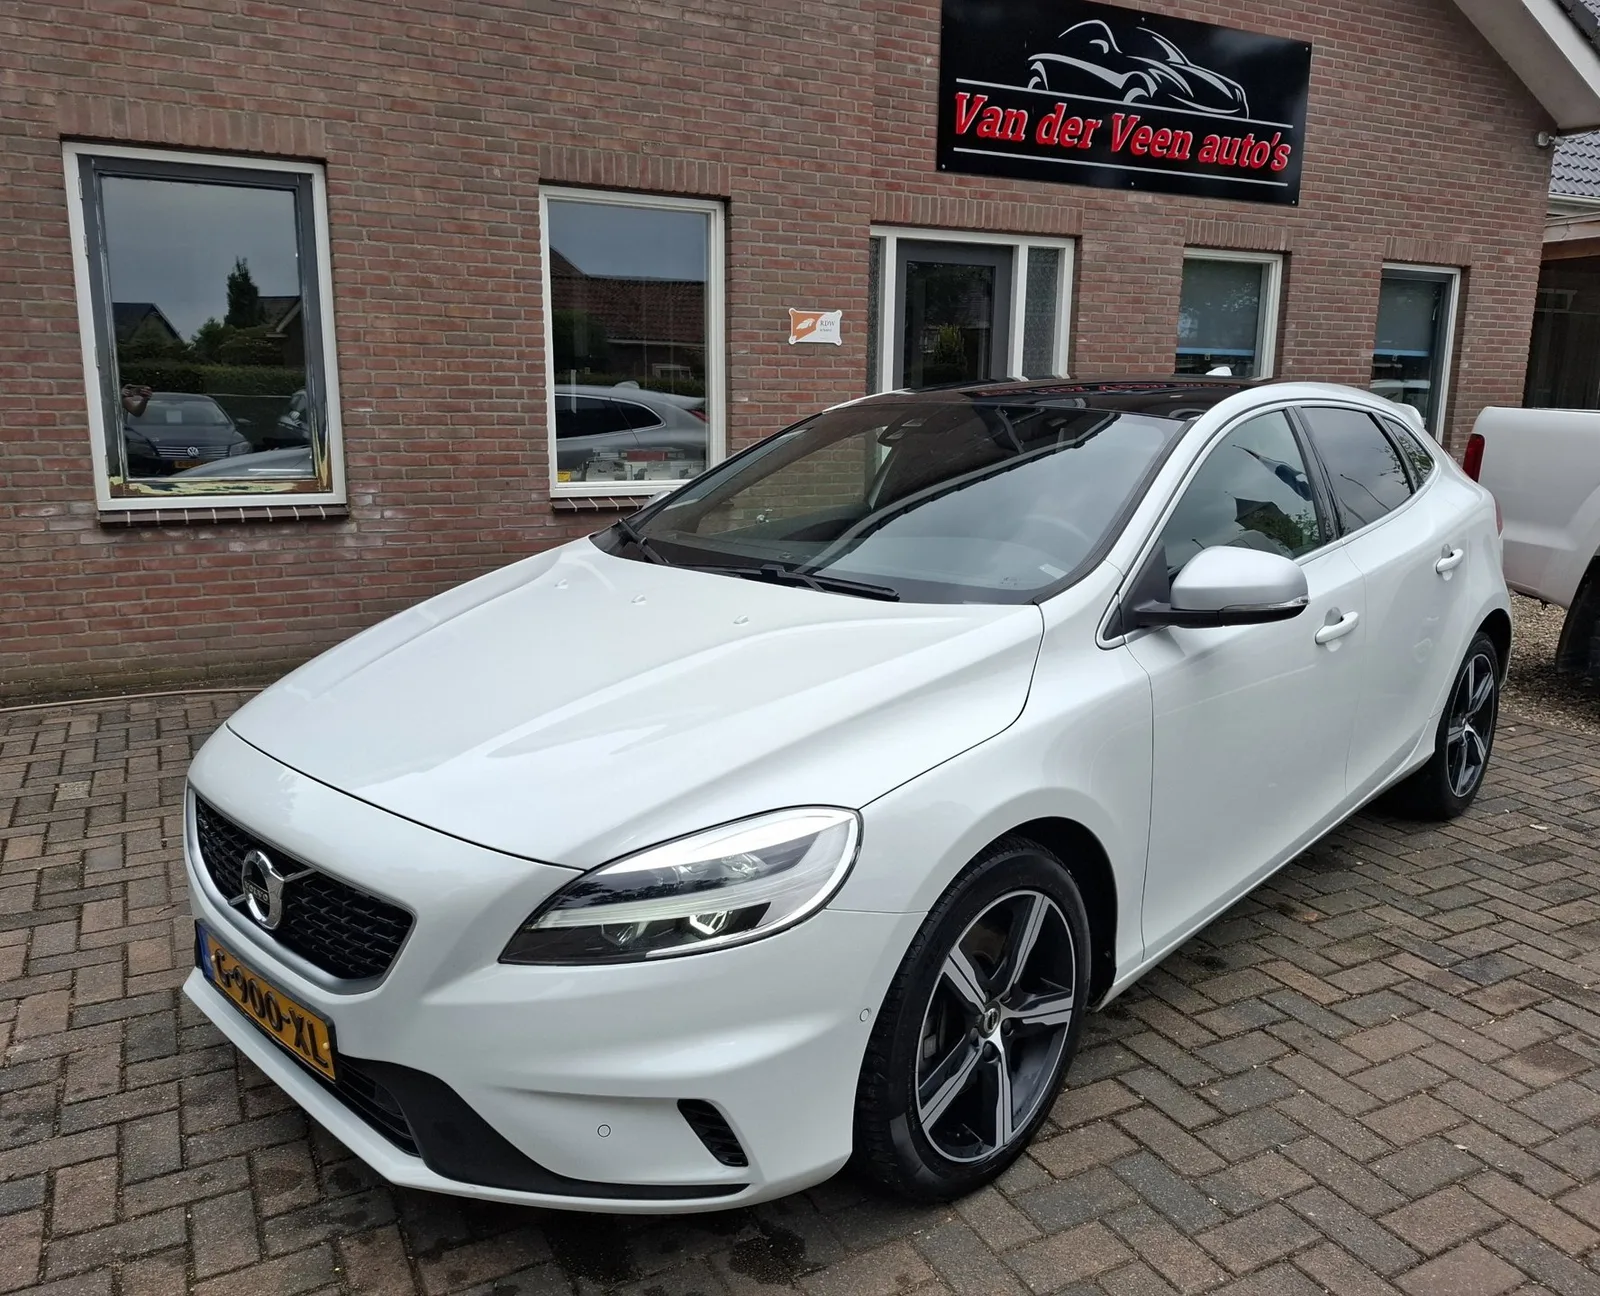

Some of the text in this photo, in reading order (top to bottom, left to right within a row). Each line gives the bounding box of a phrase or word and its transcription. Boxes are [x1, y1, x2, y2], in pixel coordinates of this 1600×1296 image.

[954, 92, 1291, 170] Van der Veen auto's
